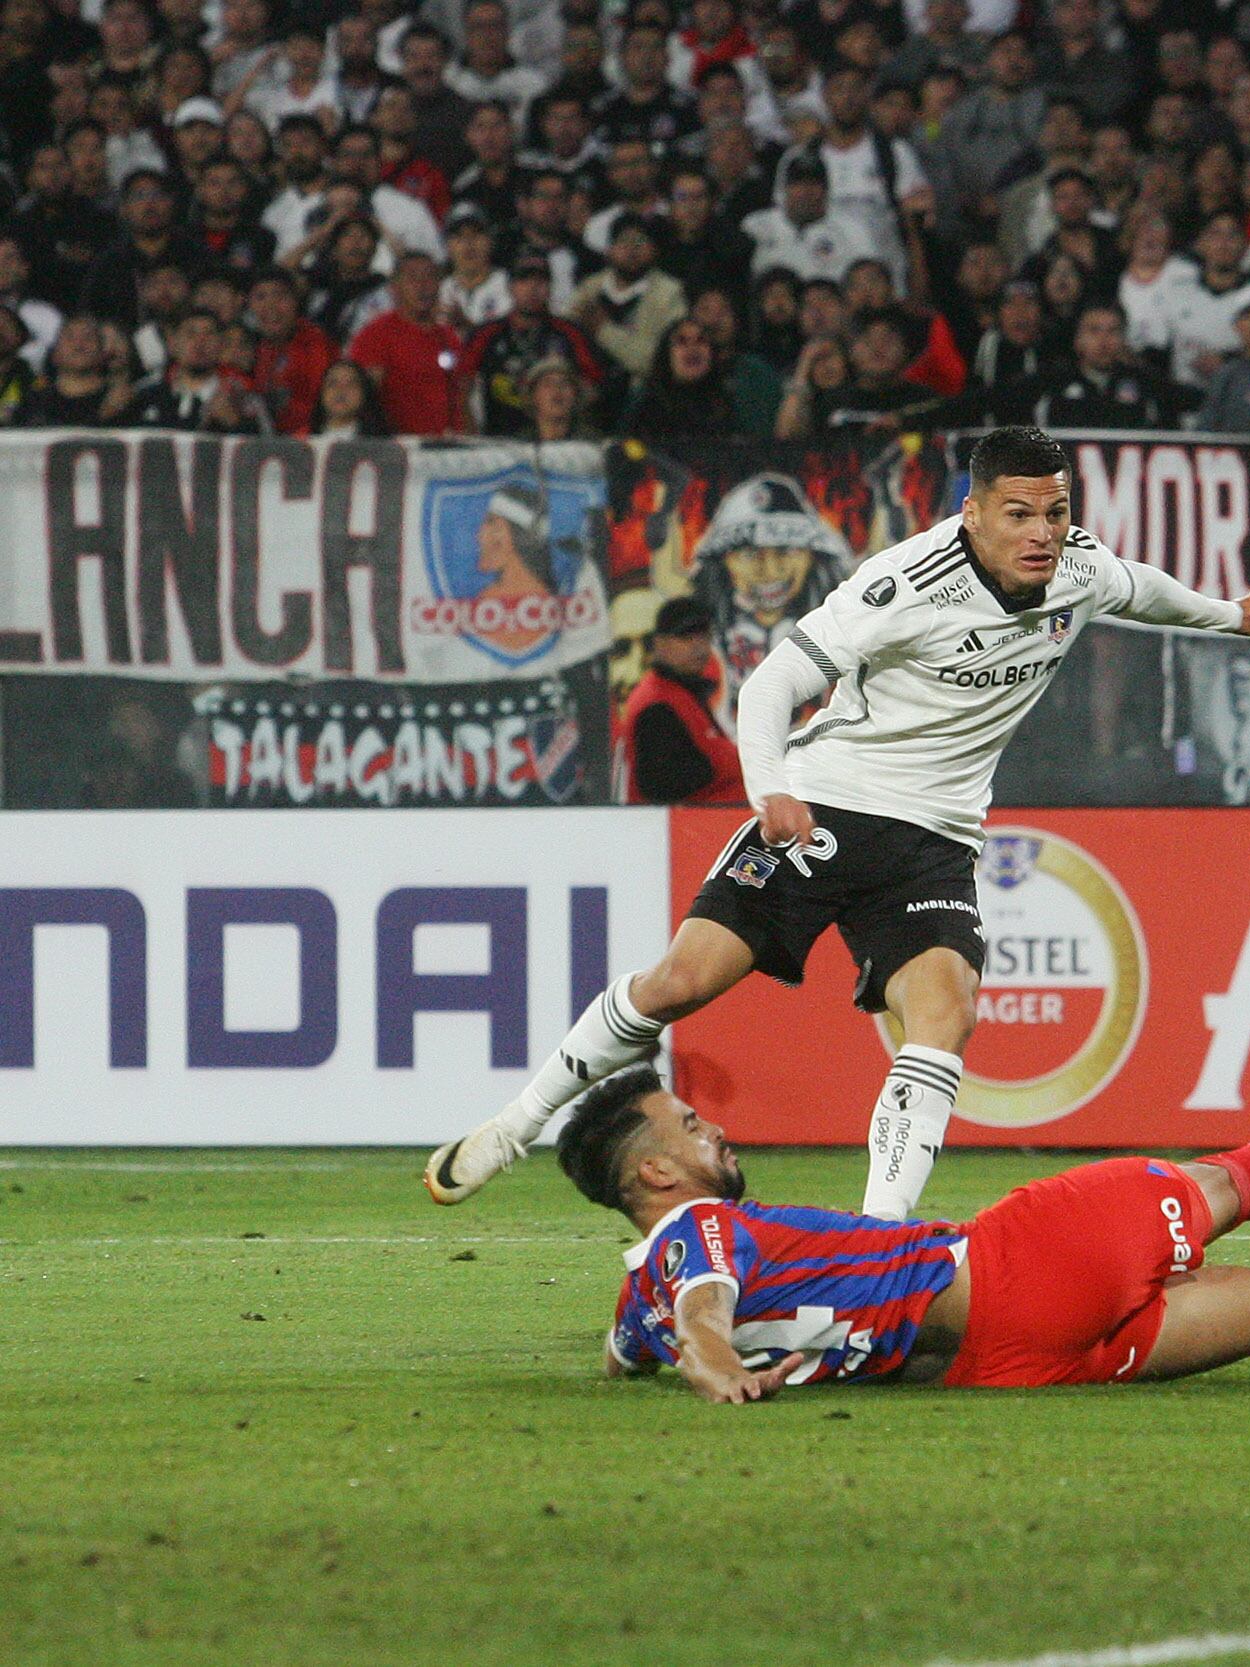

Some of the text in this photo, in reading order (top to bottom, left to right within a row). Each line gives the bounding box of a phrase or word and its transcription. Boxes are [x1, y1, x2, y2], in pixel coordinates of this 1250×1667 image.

[1077, 444, 1250, 600] MOR
[928, 573, 970, 605] Pilsen
[950, 584, 977, 607] Sur
[1072, 573, 1093, 588] Sur
[992, 624, 1045, 646] JETOUR
[937, 660, 1043, 689] COOLBET
[209, 716, 530, 803] TALAGANTE
[985, 936, 1090, 976] STEL
[976, 993, 1065, 1025] AGER
[874, 1116, 890, 1154] pago
[885, 1117, 912, 1183] mercado
